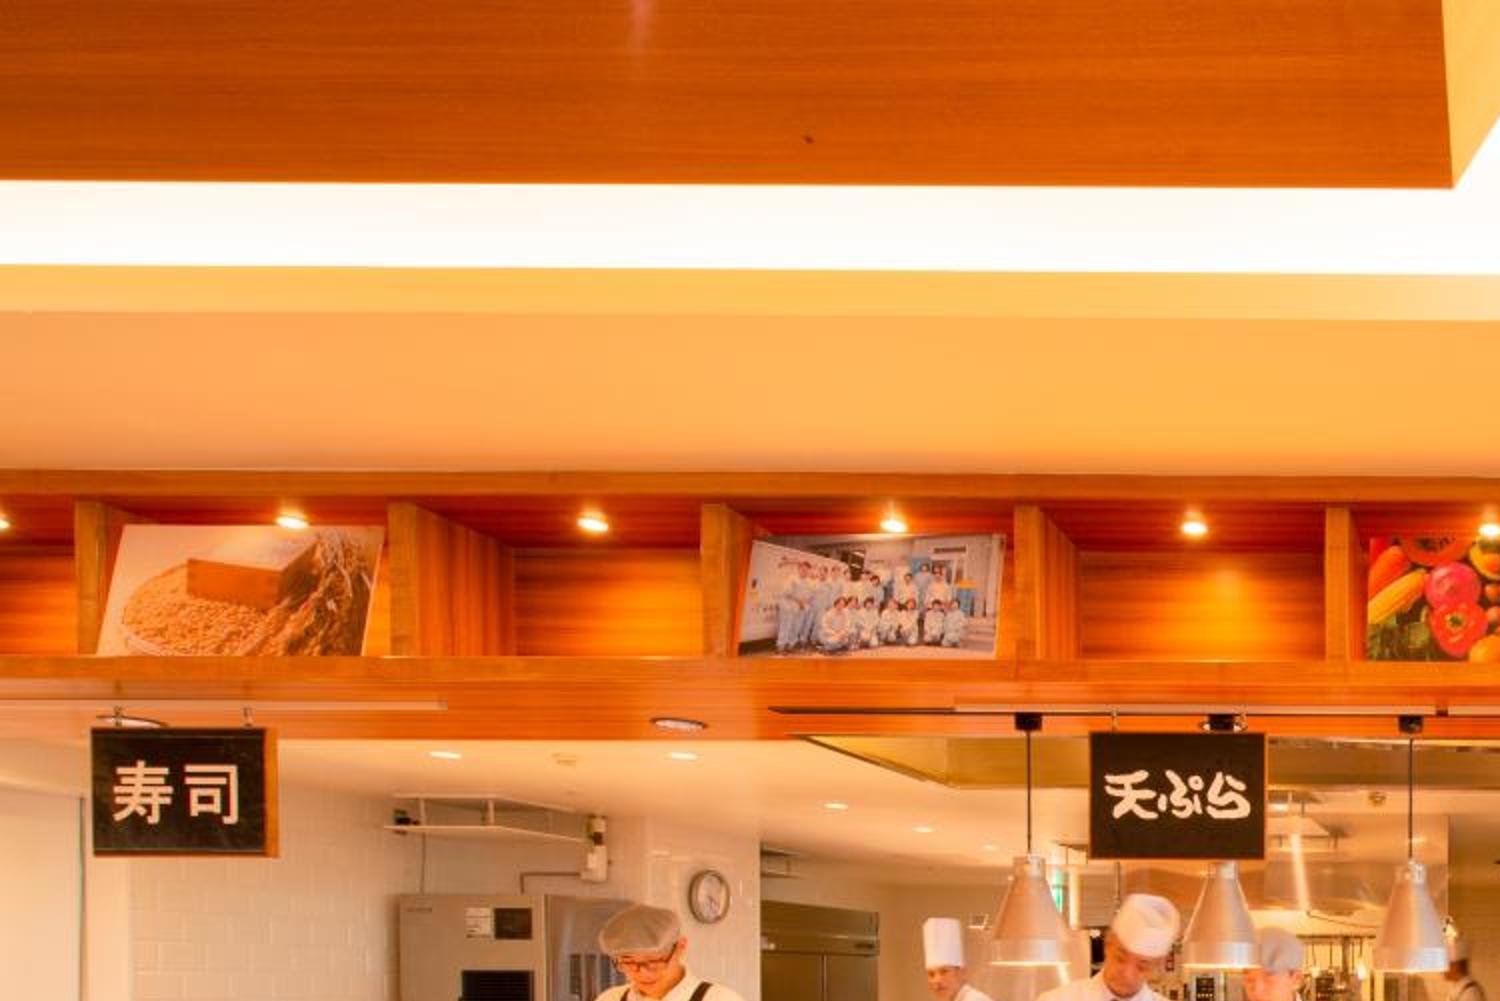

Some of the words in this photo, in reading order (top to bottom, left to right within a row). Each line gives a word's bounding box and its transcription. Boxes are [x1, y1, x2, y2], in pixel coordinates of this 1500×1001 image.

[113, 760, 238, 824] 寿司
[1104, 769, 1251, 819] 天ぷら
